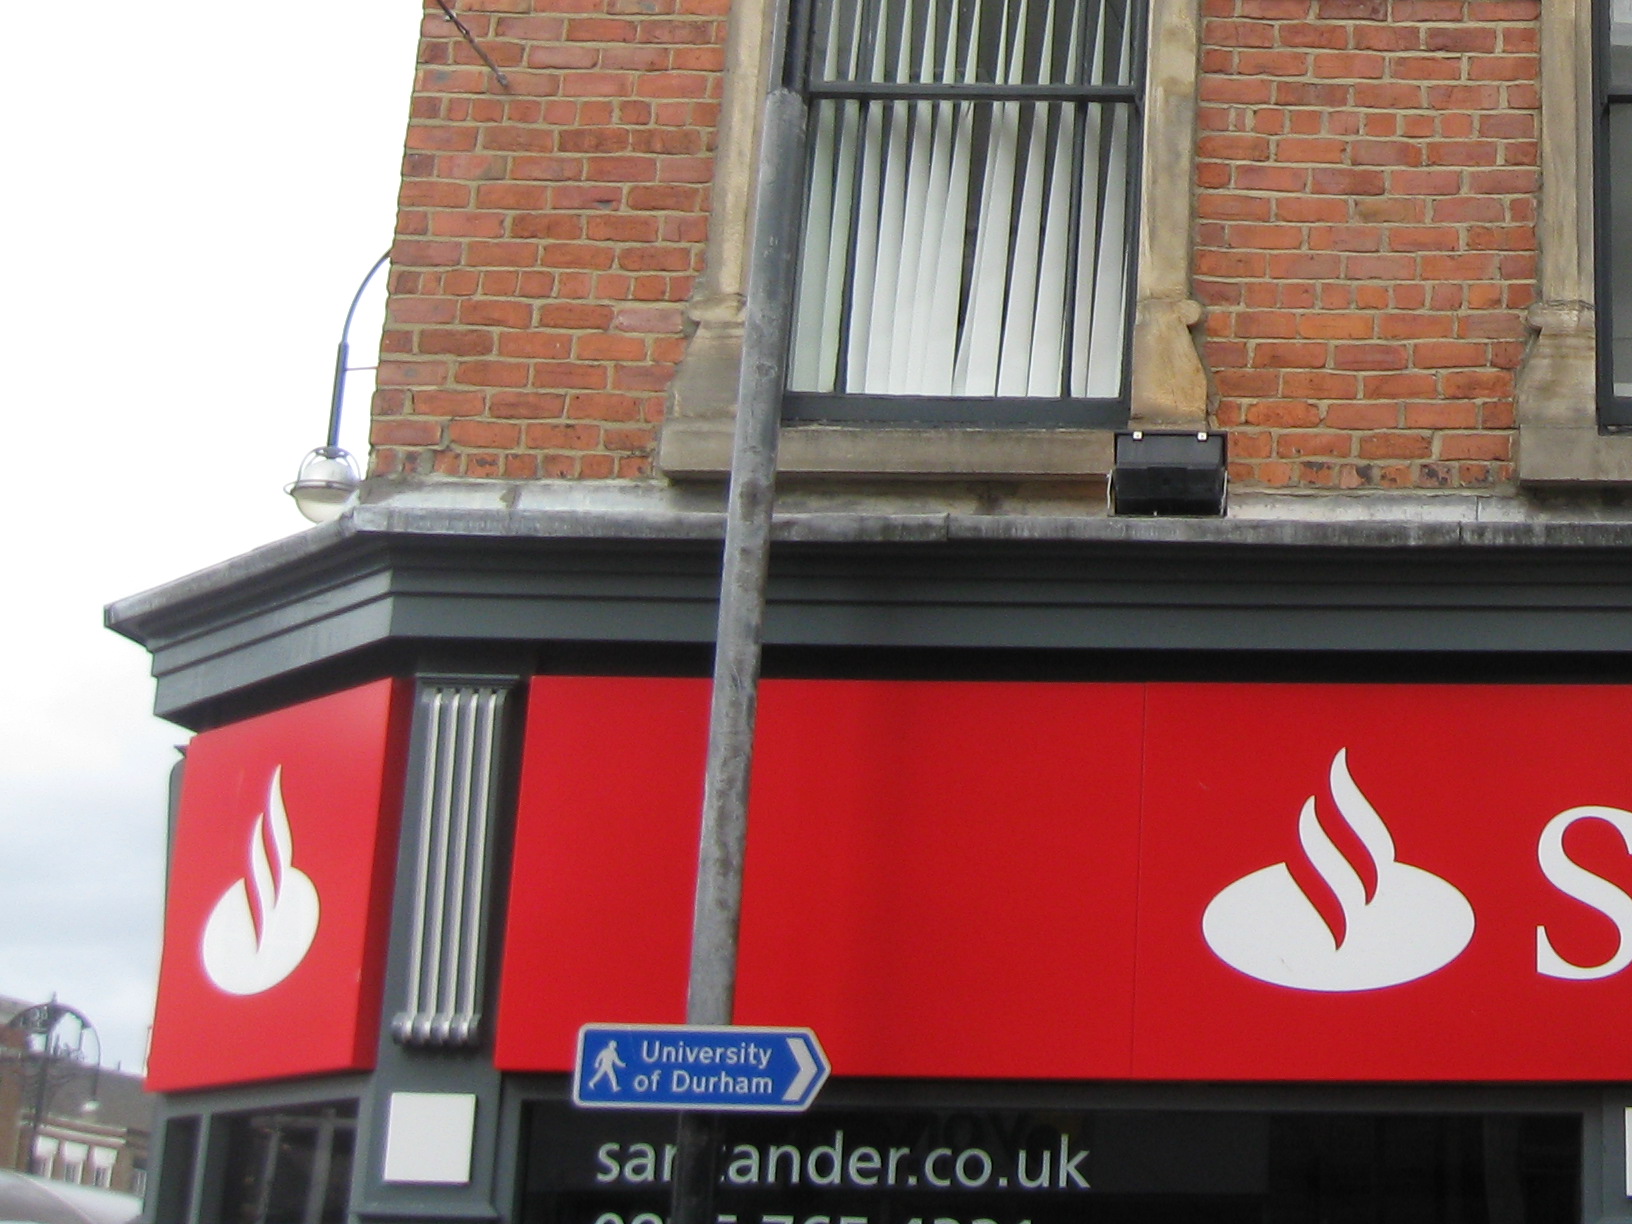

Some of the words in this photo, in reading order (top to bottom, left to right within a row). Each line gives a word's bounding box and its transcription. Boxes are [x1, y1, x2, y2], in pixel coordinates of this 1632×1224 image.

[642, 1040, 772, 1068] University
[633, 1070, 662, 1092] of
[671, 1072, 773, 1094] Durham
[596, 1130, 1091, 1189] saander.co.uk
